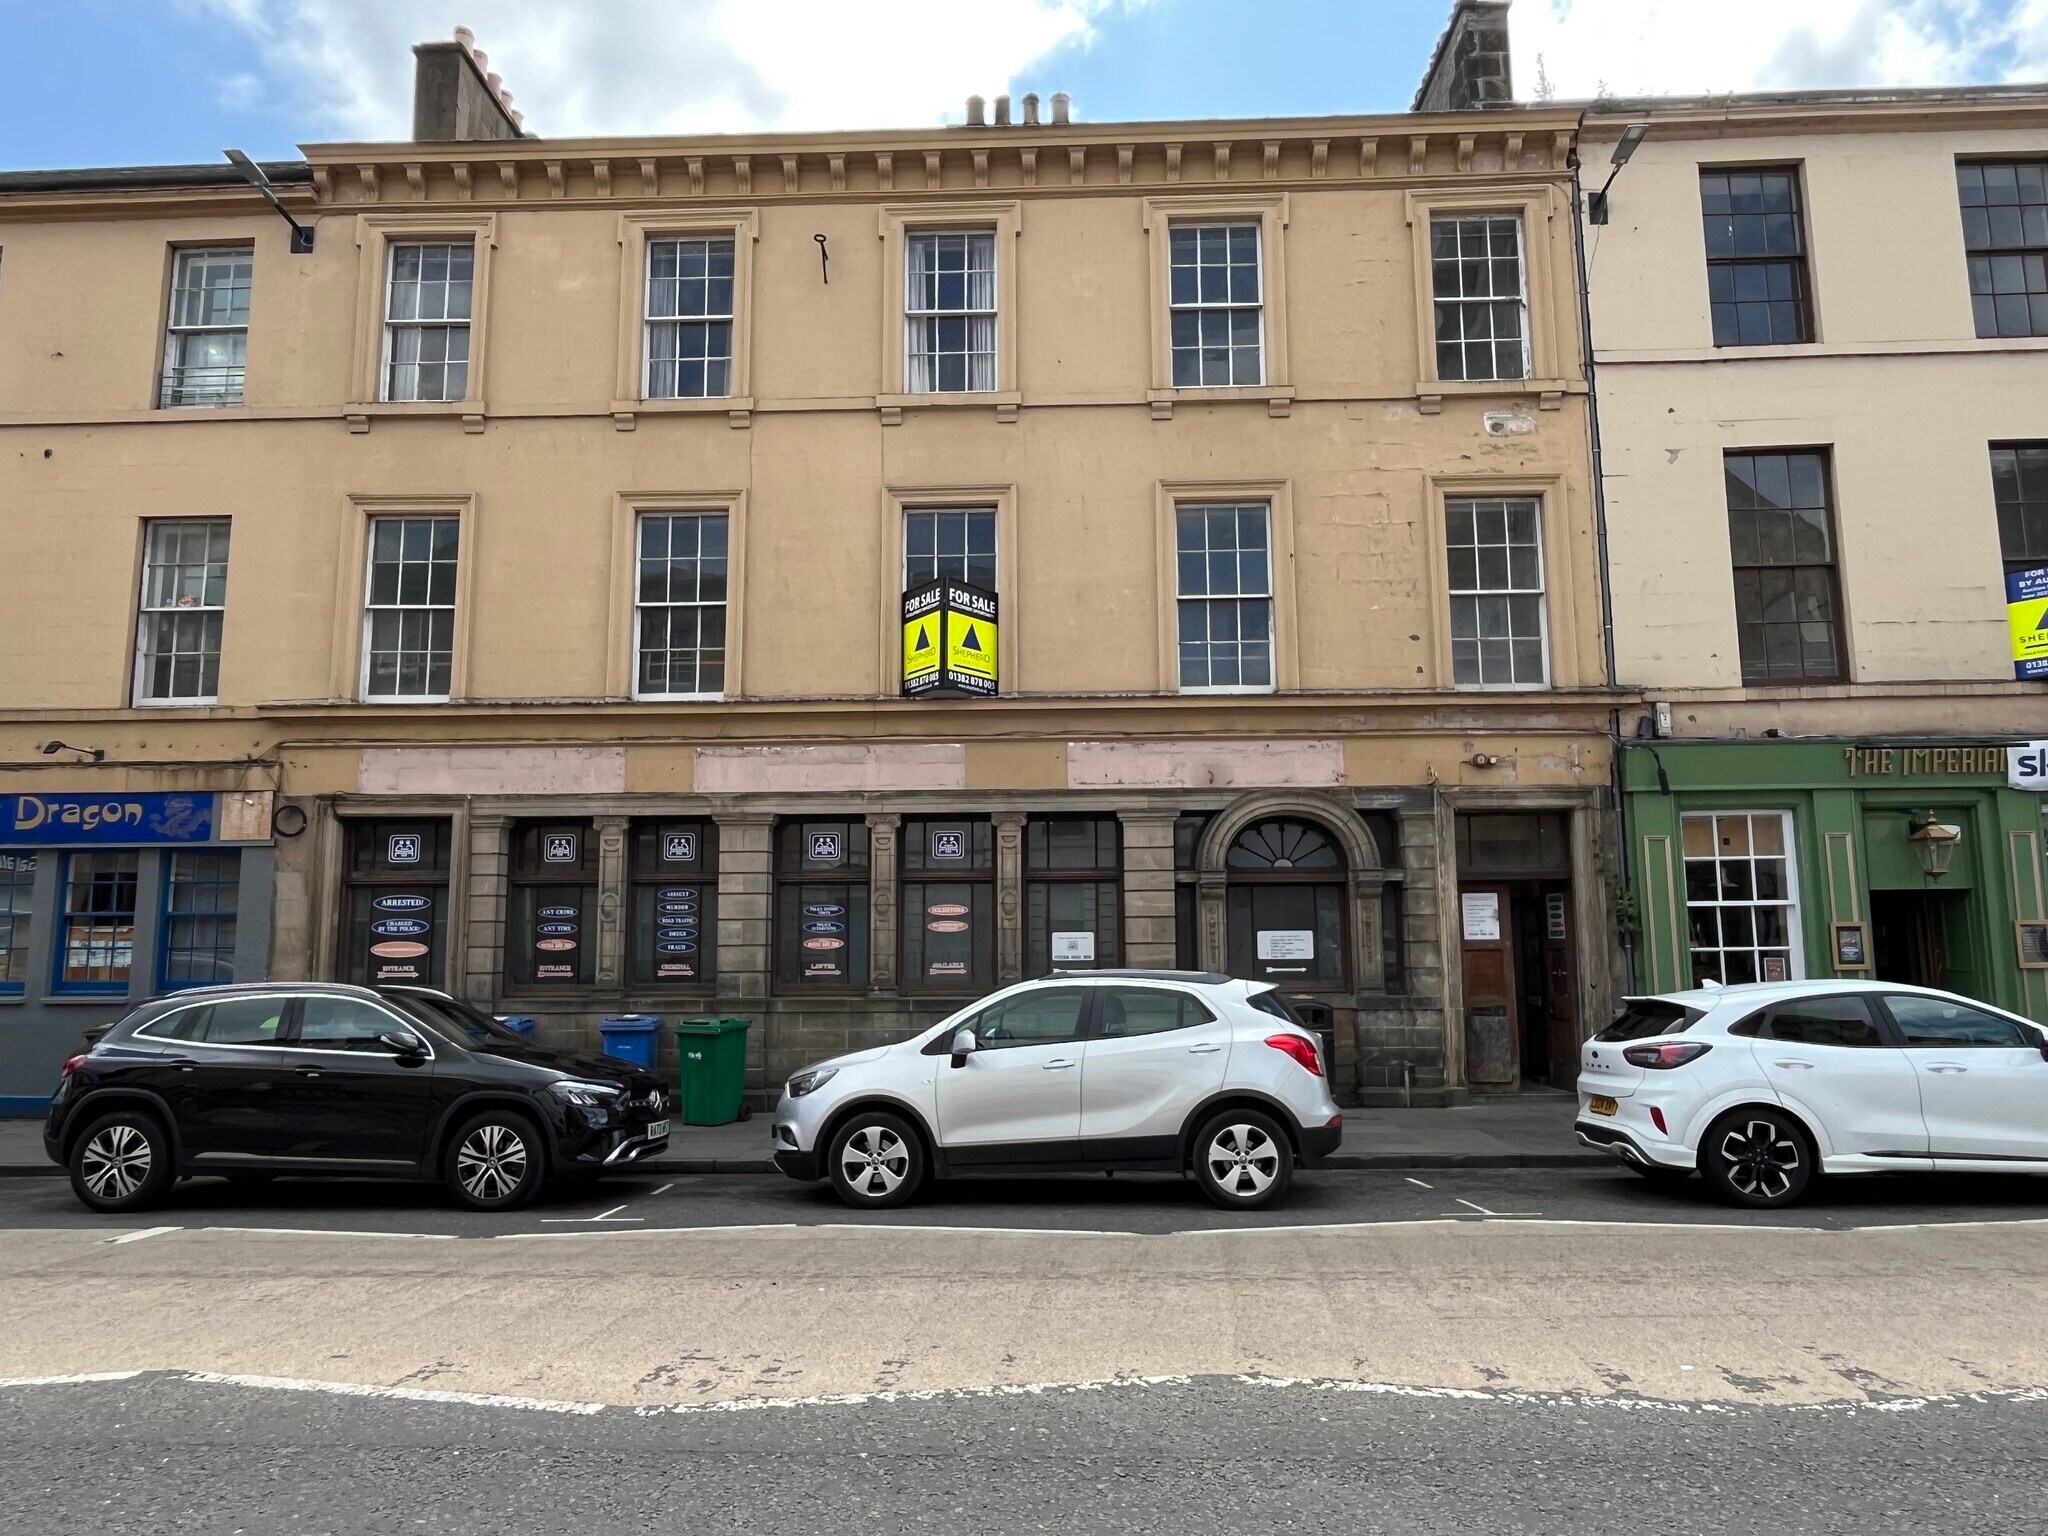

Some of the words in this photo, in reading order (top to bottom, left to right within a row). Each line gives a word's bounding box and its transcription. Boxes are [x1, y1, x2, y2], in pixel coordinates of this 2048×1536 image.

[2025, 569, 2045, 578] FOR
[2019, 580, 2032, 588] BY
[905, 597, 920, 614] FOR
[921, 588, 941, 607] SALE
[949, 588, 970, 606] FOR
[972, 596, 996, 614] SALE
[2019, 633, 2048, 644] SHE
[953, 646, 990, 663] SHEPHERD
[948, 671, 969, 684] 01382
[970, 676, 983, 687] 878
[1844, 747, 1894, 777] THE
[15, 796, 143, 830] Dragon
